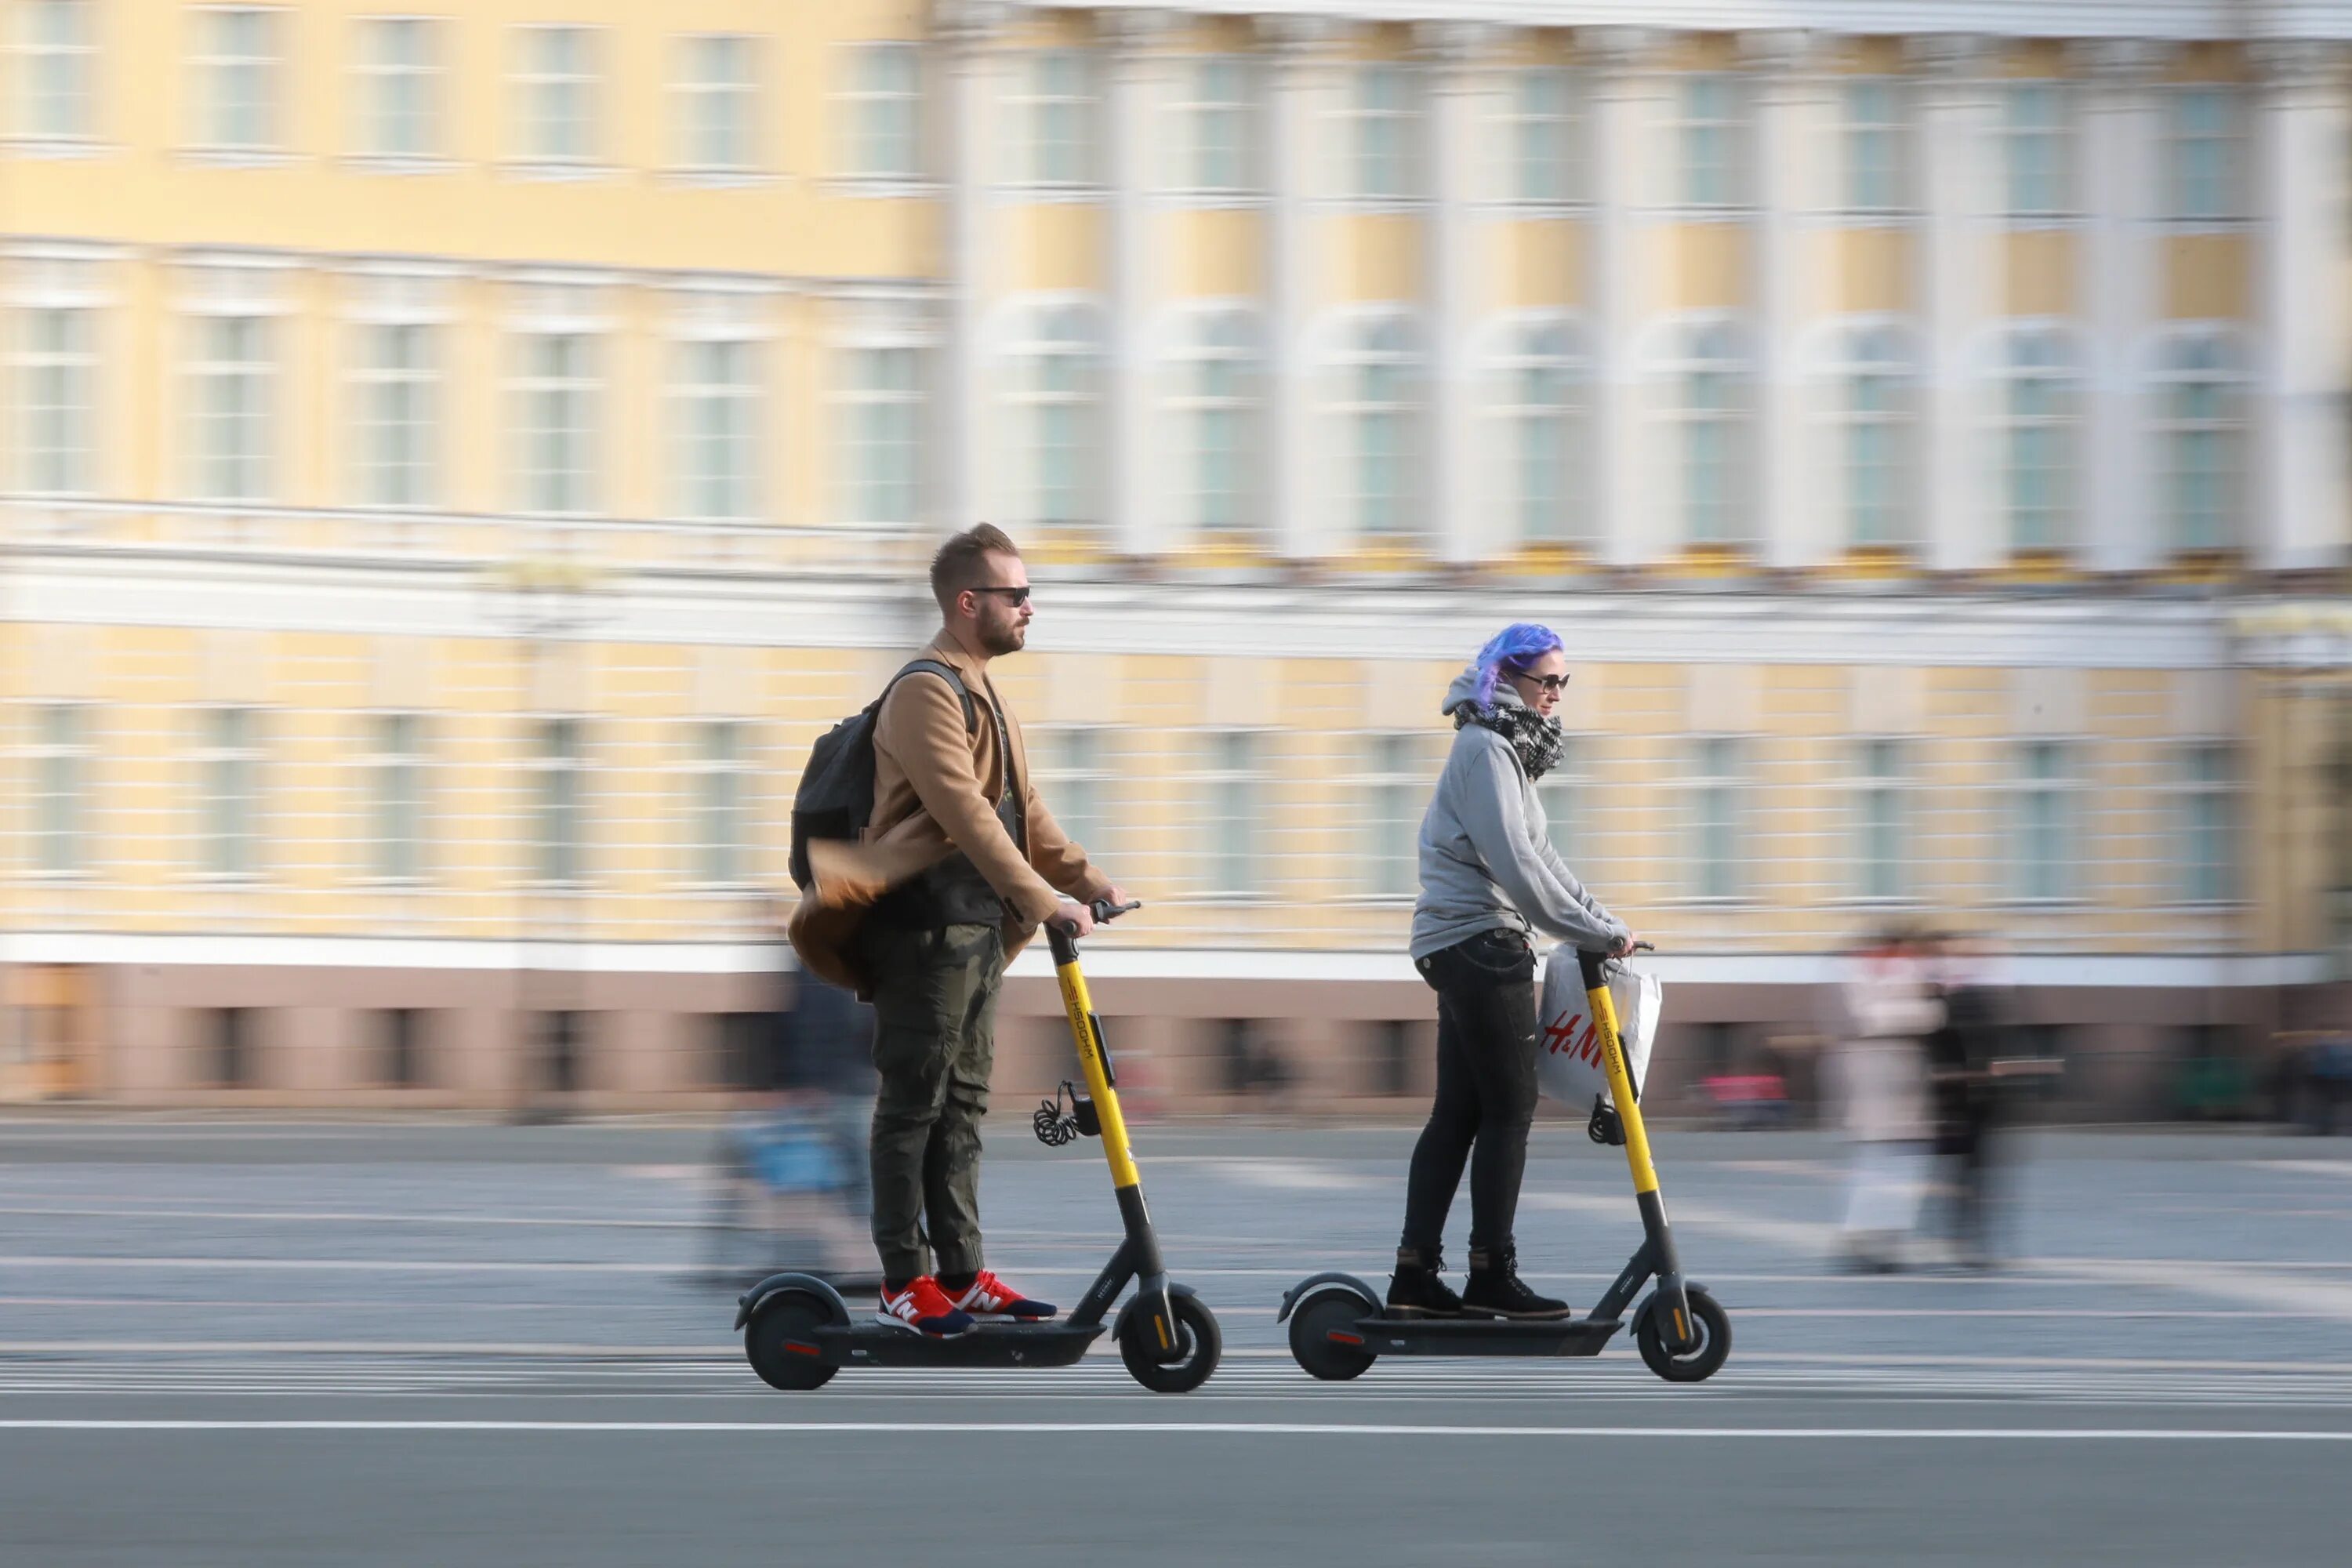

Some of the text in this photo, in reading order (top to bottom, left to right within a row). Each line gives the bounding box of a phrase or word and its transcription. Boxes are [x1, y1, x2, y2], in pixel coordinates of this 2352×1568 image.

[1071, 1002, 1094, 1058] WHOOSH
[1541, 1010, 1602, 1069] H&M
[1603, 1022, 1621, 1075] WHOOSH
[897, 1300, 920, 1322] N
[971, 1291, 1001, 1312] N
